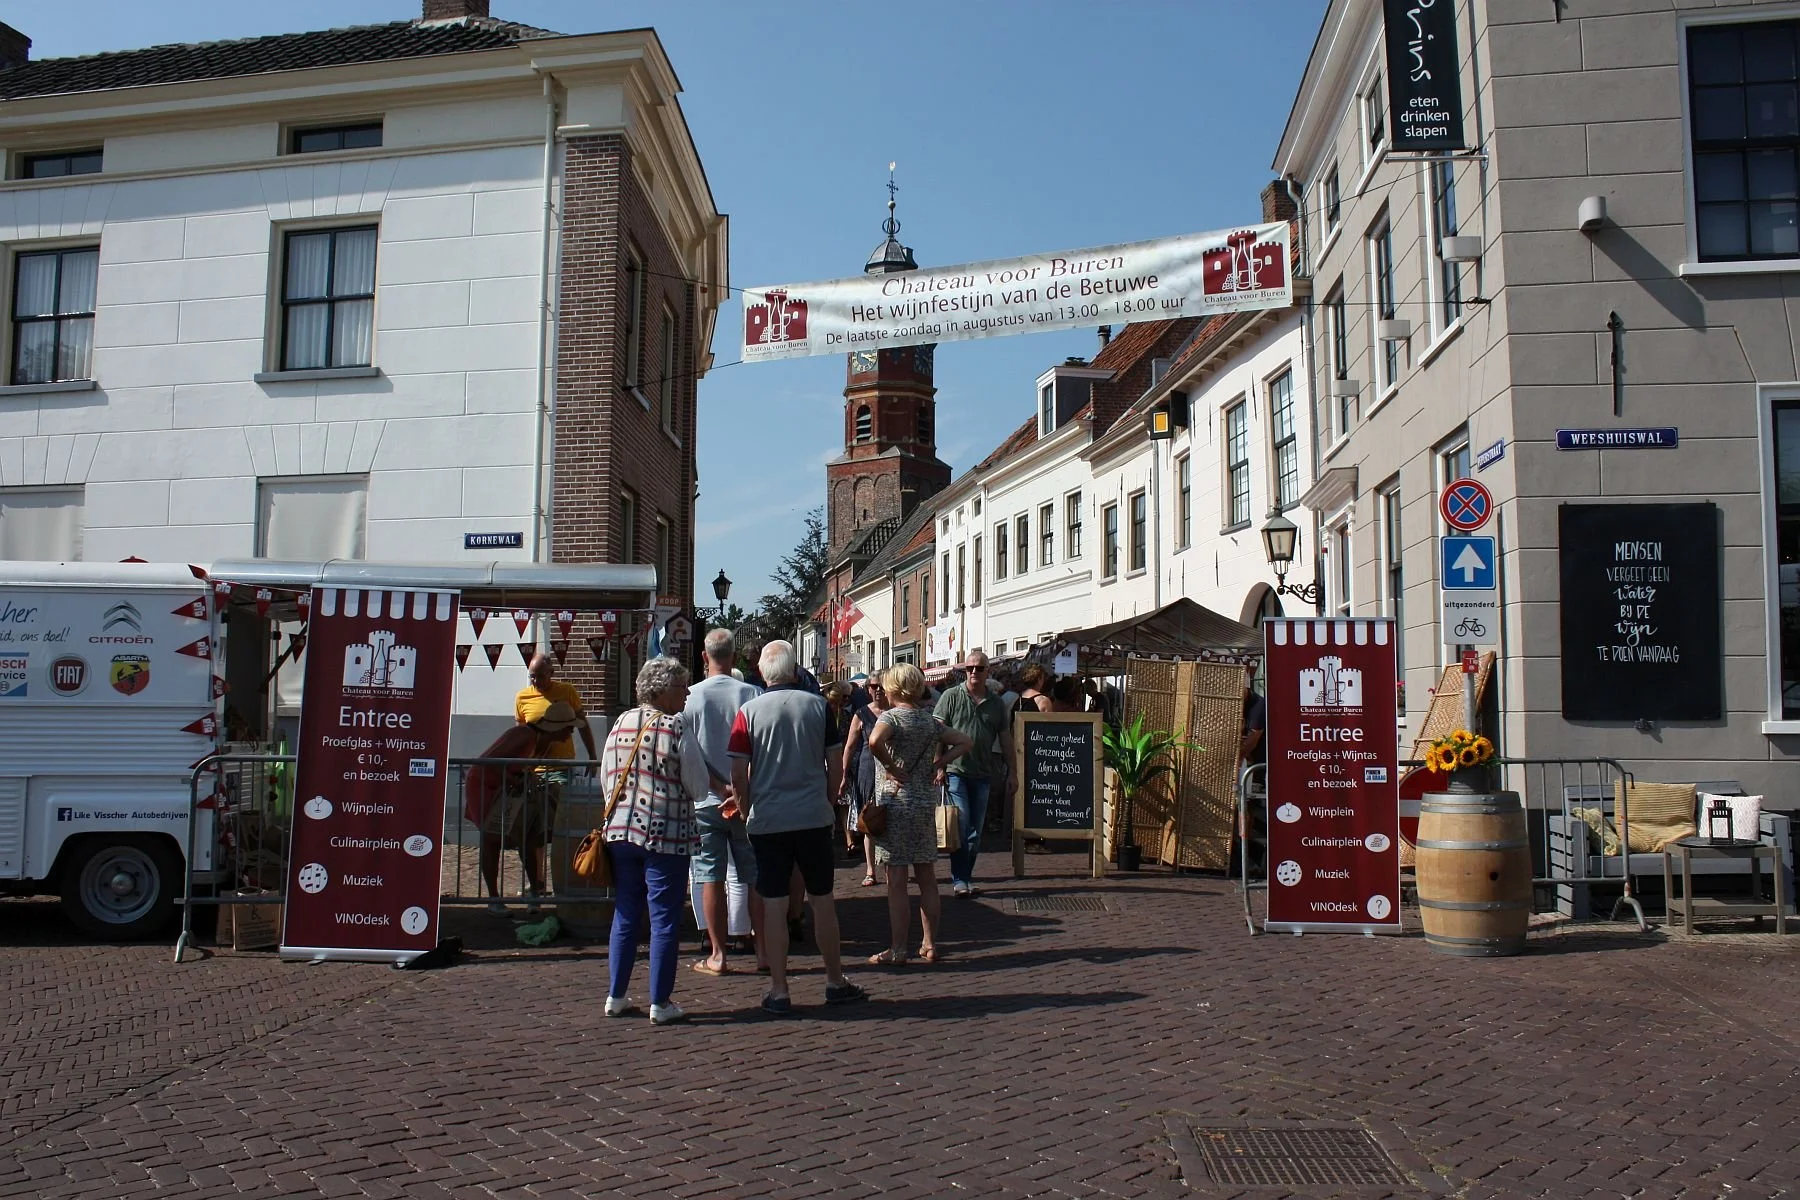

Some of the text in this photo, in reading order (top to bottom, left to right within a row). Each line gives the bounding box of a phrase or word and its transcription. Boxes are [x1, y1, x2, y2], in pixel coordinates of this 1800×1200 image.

[1409, 97, 1439, 108] eten
[1400, 110, 1450, 123] drinken
[1405, 125, 1447, 139] slapen
[882, 256, 1124, 296] Chateau voor Buren
[852, 274, 1159, 322] Het wijnfestijn van de Betuwe
[1204, 294, 1237, 303] Chateau
[1260, 290, 1286, 298] Buren
[826, 333, 842, 345] De
[847, 329, 888, 342] laatste
[893, 322, 941, 338] zondag
[946, 320, 958, 332] in
[963, 313, 1024, 332] augustus
[1029, 310, 1053, 323] van
[1059, 303, 1099, 320] 13.00
[1115, 298, 1155, 314] 18.00
[1161, 296, 1186, 309] uur
[745, 345, 771, 353] Chateau
[788, 341, 808, 349] Buren
[1571, 432, 1663, 445] WEESHUISWAL
[470, 536, 516, 545] KORNEWAL
[1615, 541, 1662, 561] MENSEN
[1606, 566, 1670, 582] VERGEET GEEN
[1444, 601, 1495, 609] uitgezonderd
[1620, 605, 1651, 618] BIJ DE
[0, 601, 38, 623] her.
[20, 633, 40, 642] ons
[43, 627, 71, 642] doel!
[1597, 646, 1680, 663] TE DOEN VANDAAG
[0, 659, 27, 669] SCH
[57, 665, 82, 684] FIAT
[342, 686, 371, 694] Chateau
[339, 706, 412, 729] Entree
[1300, 723, 1364, 742] Entree
[322, 735, 372, 750] Proefglas
[385, 739, 426, 752] Wijntas
[1061, 732, 1085, 747] geheel
[358, 754, 388, 766] € 10,-
[1287, 750, 1332, 762] Proefglas
[1342, 750, 1378, 762] Wijntas
[1061, 763, 1081, 774] BBQ
[1319, 764, 1346, 775] € 10,-
[343, 770, 400, 781] en bezoek
[1066, 784, 1075, 795] op
[1308, 779, 1357, 788] en bezoek
[342, 802, 394, 815] Wijnplein
[1308, 806, 1354, 818] Wijnplein
[74, 811, 91, 819] Like
[94, 811, 129, 819] Visscher
[132, 811, 189, 820] Autobedrijven
[330, 836, 400, 851] Culinairplein
[1301, 836, 1363, 849] Culinairplein
[343, 874, 383, 886] Muziek
[1315, 869, 1350, 879] Muziek
[1310, 902, 1358, 912] VINOdesk
[335, 913, 390, 926] VINOdesk
